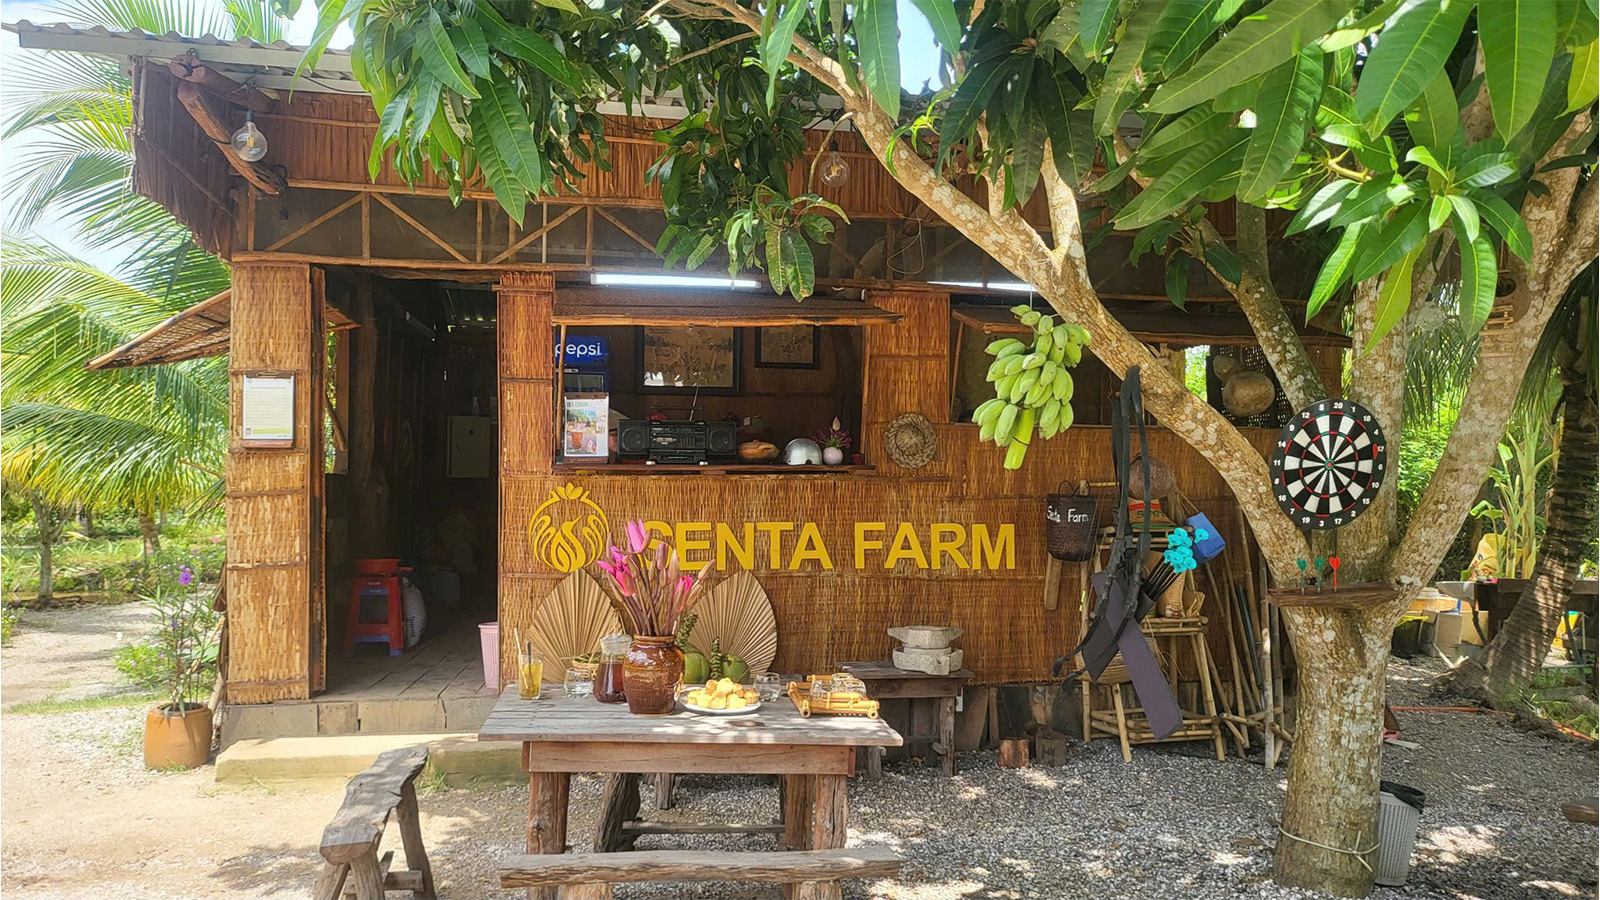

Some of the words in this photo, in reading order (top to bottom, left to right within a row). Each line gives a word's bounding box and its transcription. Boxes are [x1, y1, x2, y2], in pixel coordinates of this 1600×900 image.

[554, 342, 601, 358] pepsi
[1067, 508, 1089, 523] Farm
[638, 520, 833, 571] SENTA
[854, 522, 1015, 570] FARM
